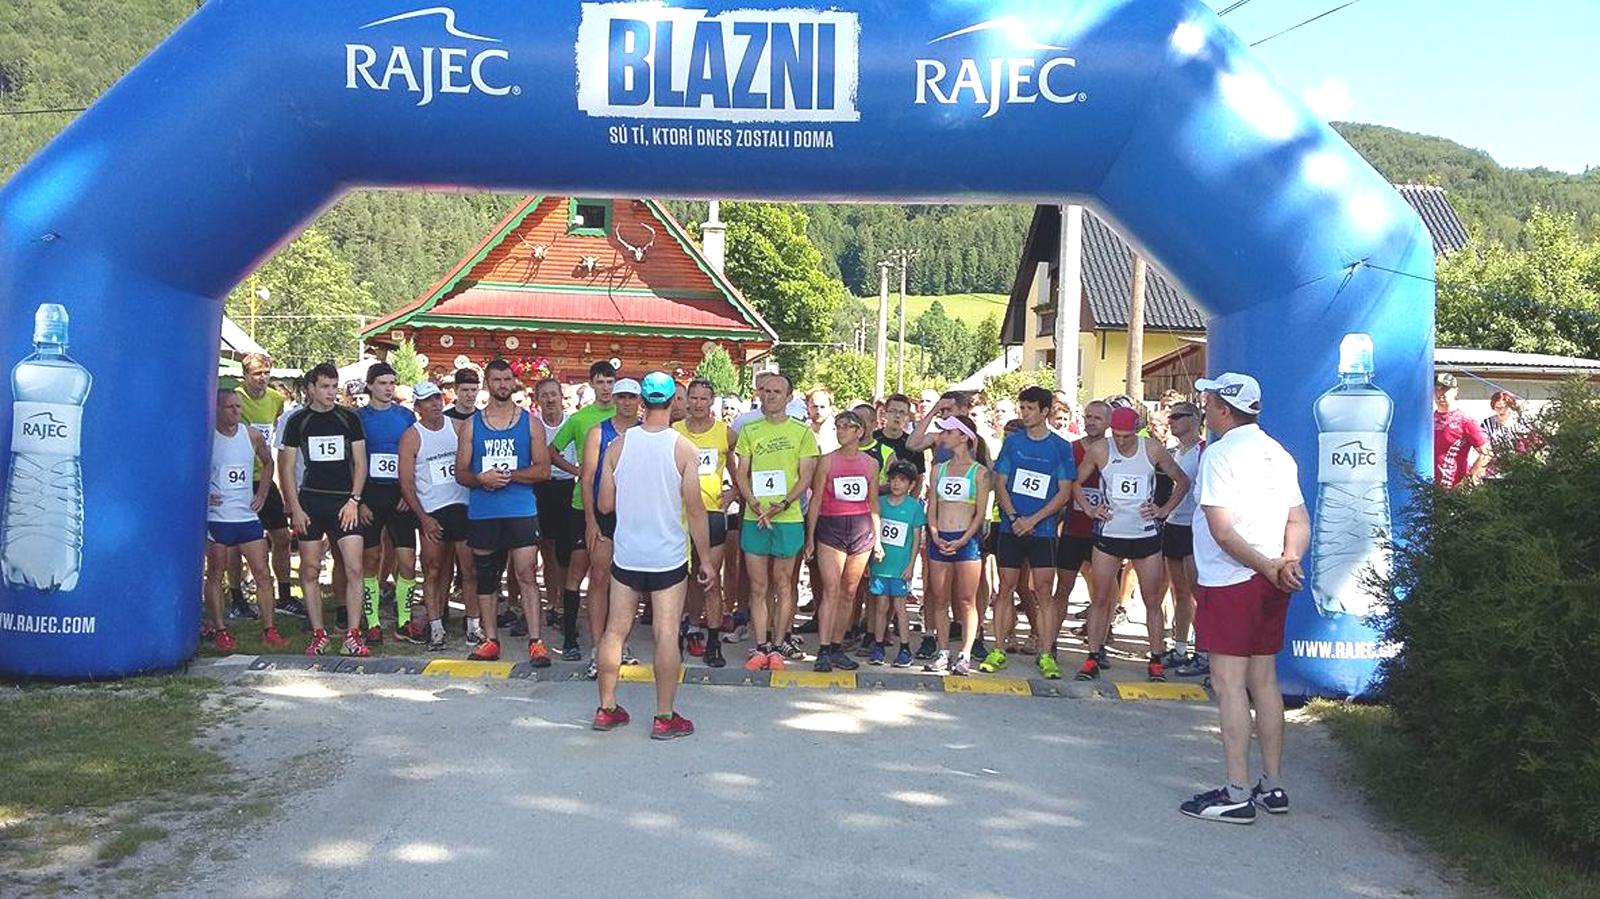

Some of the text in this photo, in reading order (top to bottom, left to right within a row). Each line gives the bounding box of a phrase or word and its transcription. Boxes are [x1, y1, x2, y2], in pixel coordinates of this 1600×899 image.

[608, 123, 834, 149] SÚ TÍ, KTORÍ DNES ZOSTALI DOMA
[22, 422, 68, 440] RAJEC
[318, 442, 338, 456] 15
[484, 438, 515, 451] WORK
[378, 459, 397, 473] 36
[698, 454, 711, 466] 4
[1331, 451, 1377, 469] RAJEC
[228, 470, 247, 484] 94
[440, 464, 457, 478] 16
[765, 477, 775, 490] 4
[842, 482, 861, 496] 39
[943, 482, 962, 496] 52
[1021, 477, 1041, 492] 45
[1120, 480, 1139, 495] 61
[881, 525, 899, 540] 69
